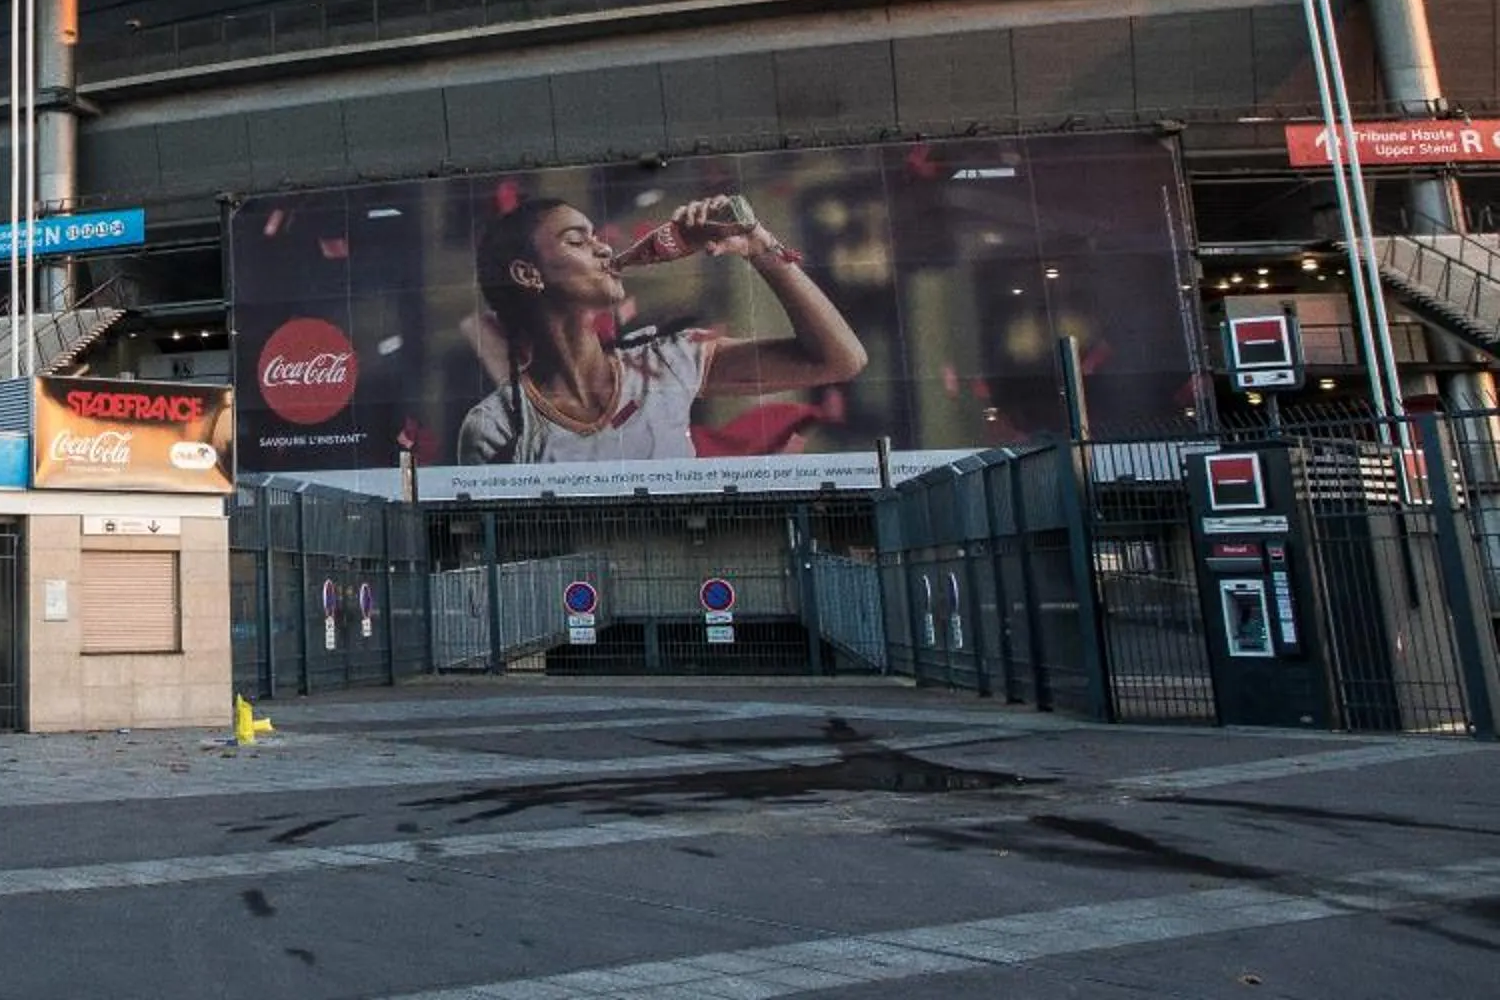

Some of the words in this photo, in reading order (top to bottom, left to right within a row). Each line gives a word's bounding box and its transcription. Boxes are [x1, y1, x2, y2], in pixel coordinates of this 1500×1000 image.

[1352, 129, 1407, 142] Tribune
[1411, 128, 1455, 141] Haute
[1460, 129, 1483, 153] R
[1375, 143, 1415, 157] Upper
[45, 225, 61, 246] N
[264, 352, 353, 387] Coca-Cola
[67, 391, 204, 422] STADEFRANCE
[51, 428, 132, 463] Coca-Cola
[773, 467, 793, 480] par
